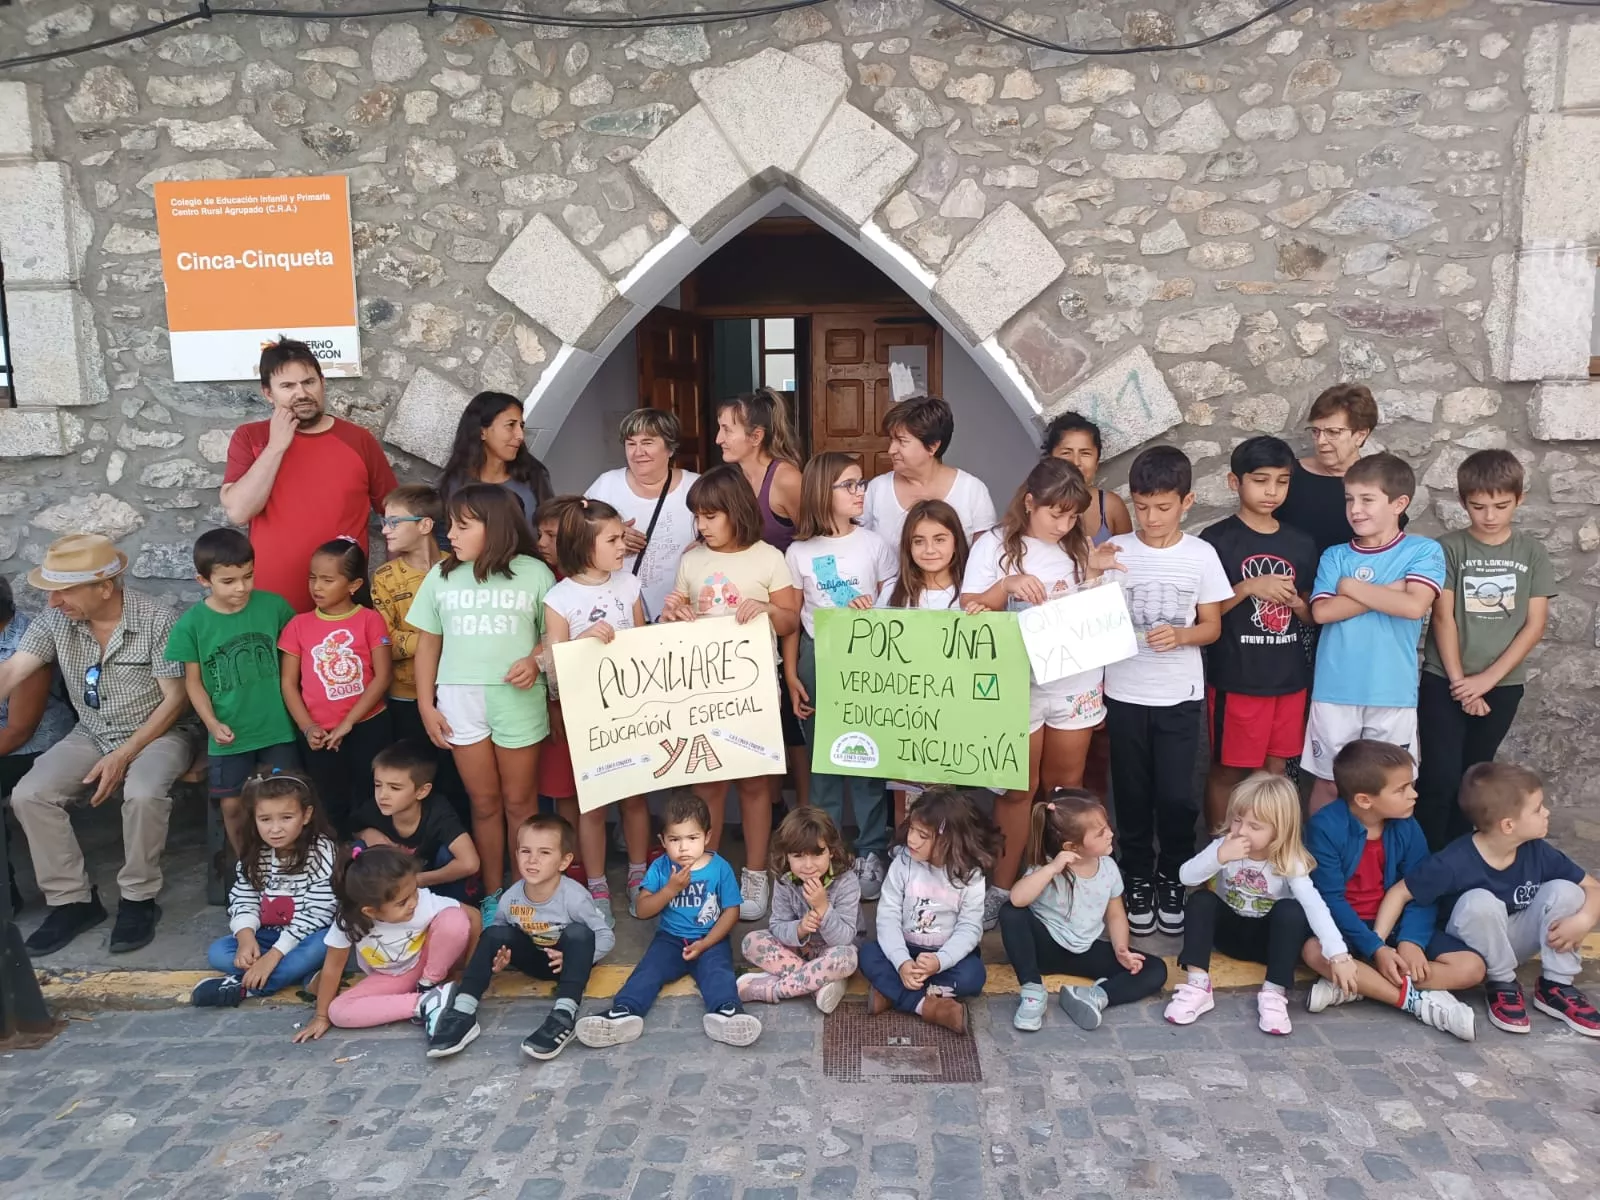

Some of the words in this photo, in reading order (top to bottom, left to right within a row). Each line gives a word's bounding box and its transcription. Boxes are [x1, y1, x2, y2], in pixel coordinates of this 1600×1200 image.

[170, 197, 202, 207] Colegio
[204, 197, 214, 205] de
[216, 194, 257, 204] Educación
[260, 195, 288, 203] Infantil
[297, 192, 331, 201] Primaria
[172, 208, 199, 216] Centro
[201, 206, 222, 215] Rural
[225, 205, 263, 215] Agrupado
[266, 204, 297, 214] (C.R.A.)
[177, 249, 333, 271] Cinca-Cinqueta
[451, 614, 519, 636] COAST
[847, 616, 912, 664] POR
[941, 616, 998, 660] UNA
[598, 639, 760, 710] AUXILIARES
[1035, 645, 1082, 680] YA
[329, 682, 361, 698] 2008
[840, 670, 955, 699] VERDADERA
[589, 709, 674, 752] EDUCACIÓN
[689, 695, 764, 726] ESPECIAL
[653, 733, 723, 779] YA
[669, 896, 702, 908] WILD
